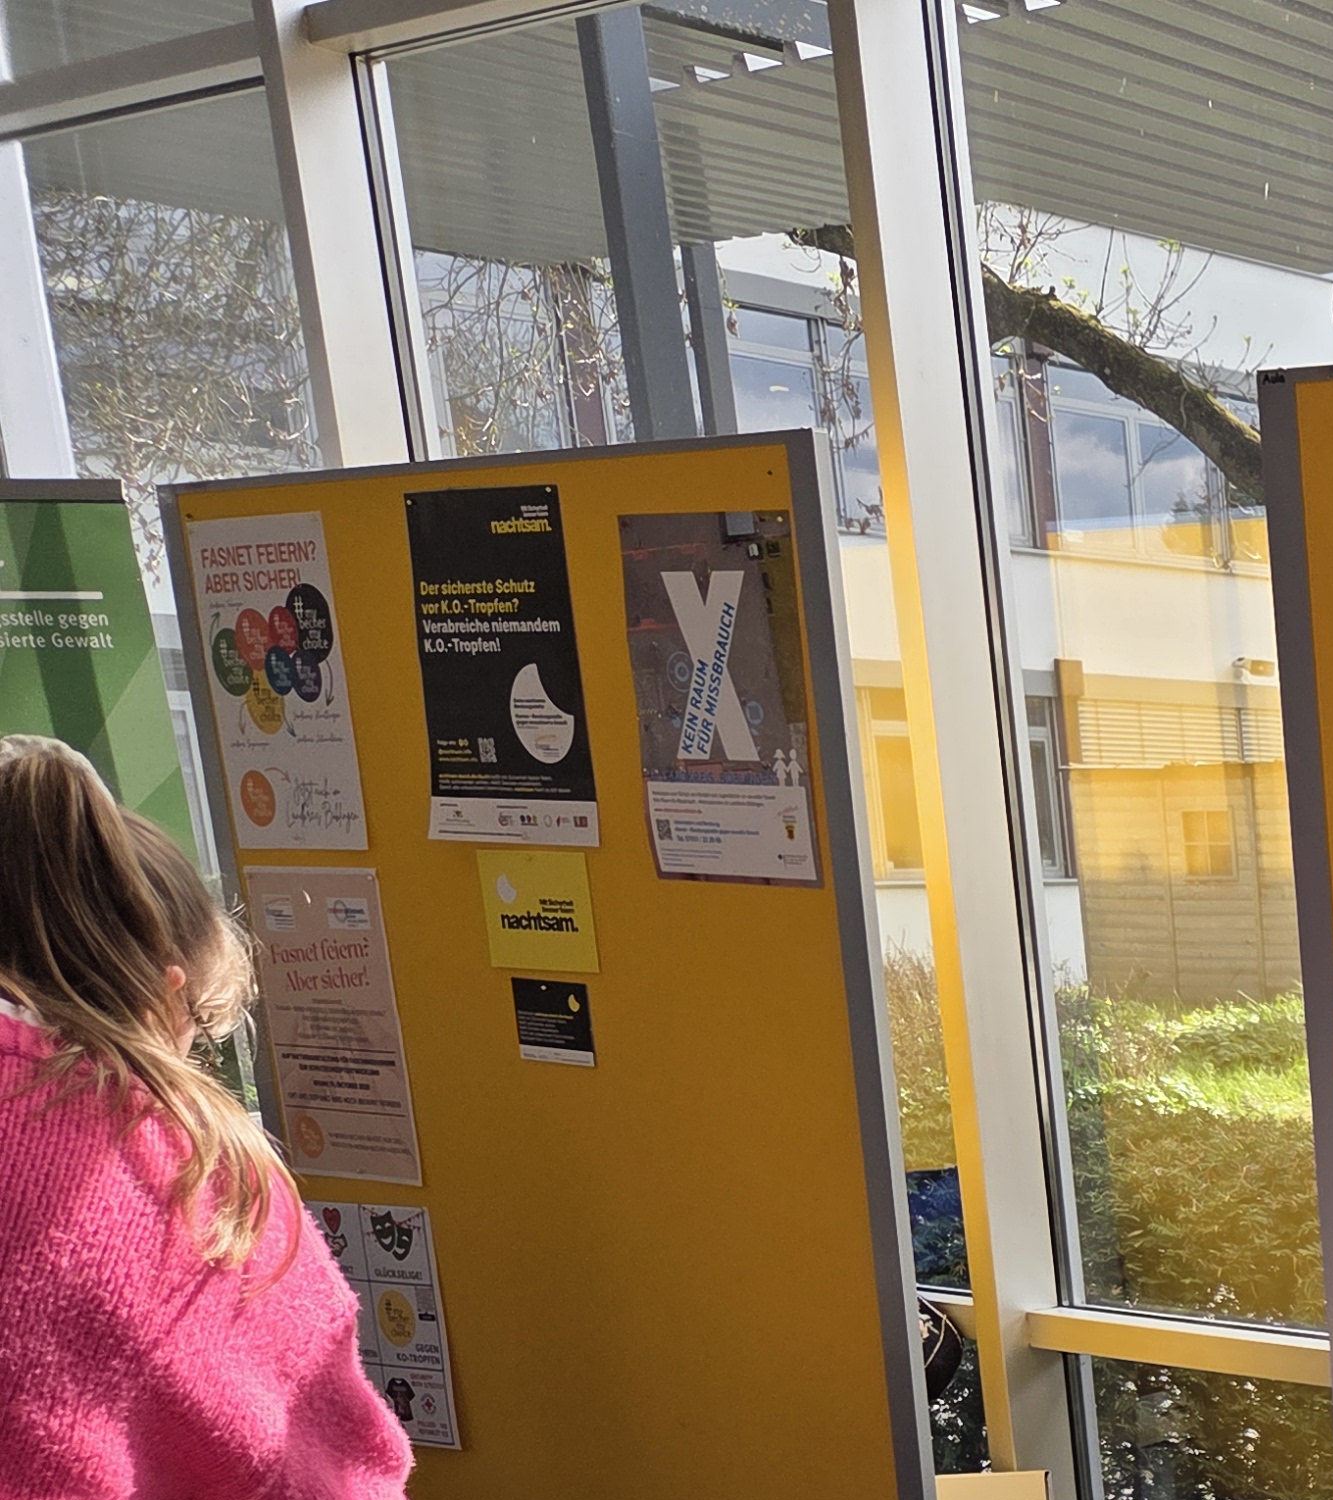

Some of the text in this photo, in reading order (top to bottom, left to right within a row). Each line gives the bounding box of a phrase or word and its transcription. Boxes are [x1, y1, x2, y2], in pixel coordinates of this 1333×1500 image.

[491, 517, 552, 533] nachtsam.
[201, 541, 317, 569] FASNET FEIERN?
[205, 568, 301, 594] ABER SICHER!
[420, 579, 535, 595] Der sicherste Schutz
[421, 598, 519, 616] vor K.O.-Tropfen?
[0, 610, 109, 629] sstelle gegen
[423, 617, 560, 633] Verabreiche niemandem
[51, 632, 114, 648] Gewalt
[424, 638, 501, 655] K.O.-Tropfen!
[697, 602, 735, 755] FÜR MISSBRAUCH
[682, 659, 709, 754] KEIN RAUM
[501, 911, 579, 932] nachtsam.
[271, 944, 319, 965] Fasnet
[285, 966, 370, 993] Aber sicher!
